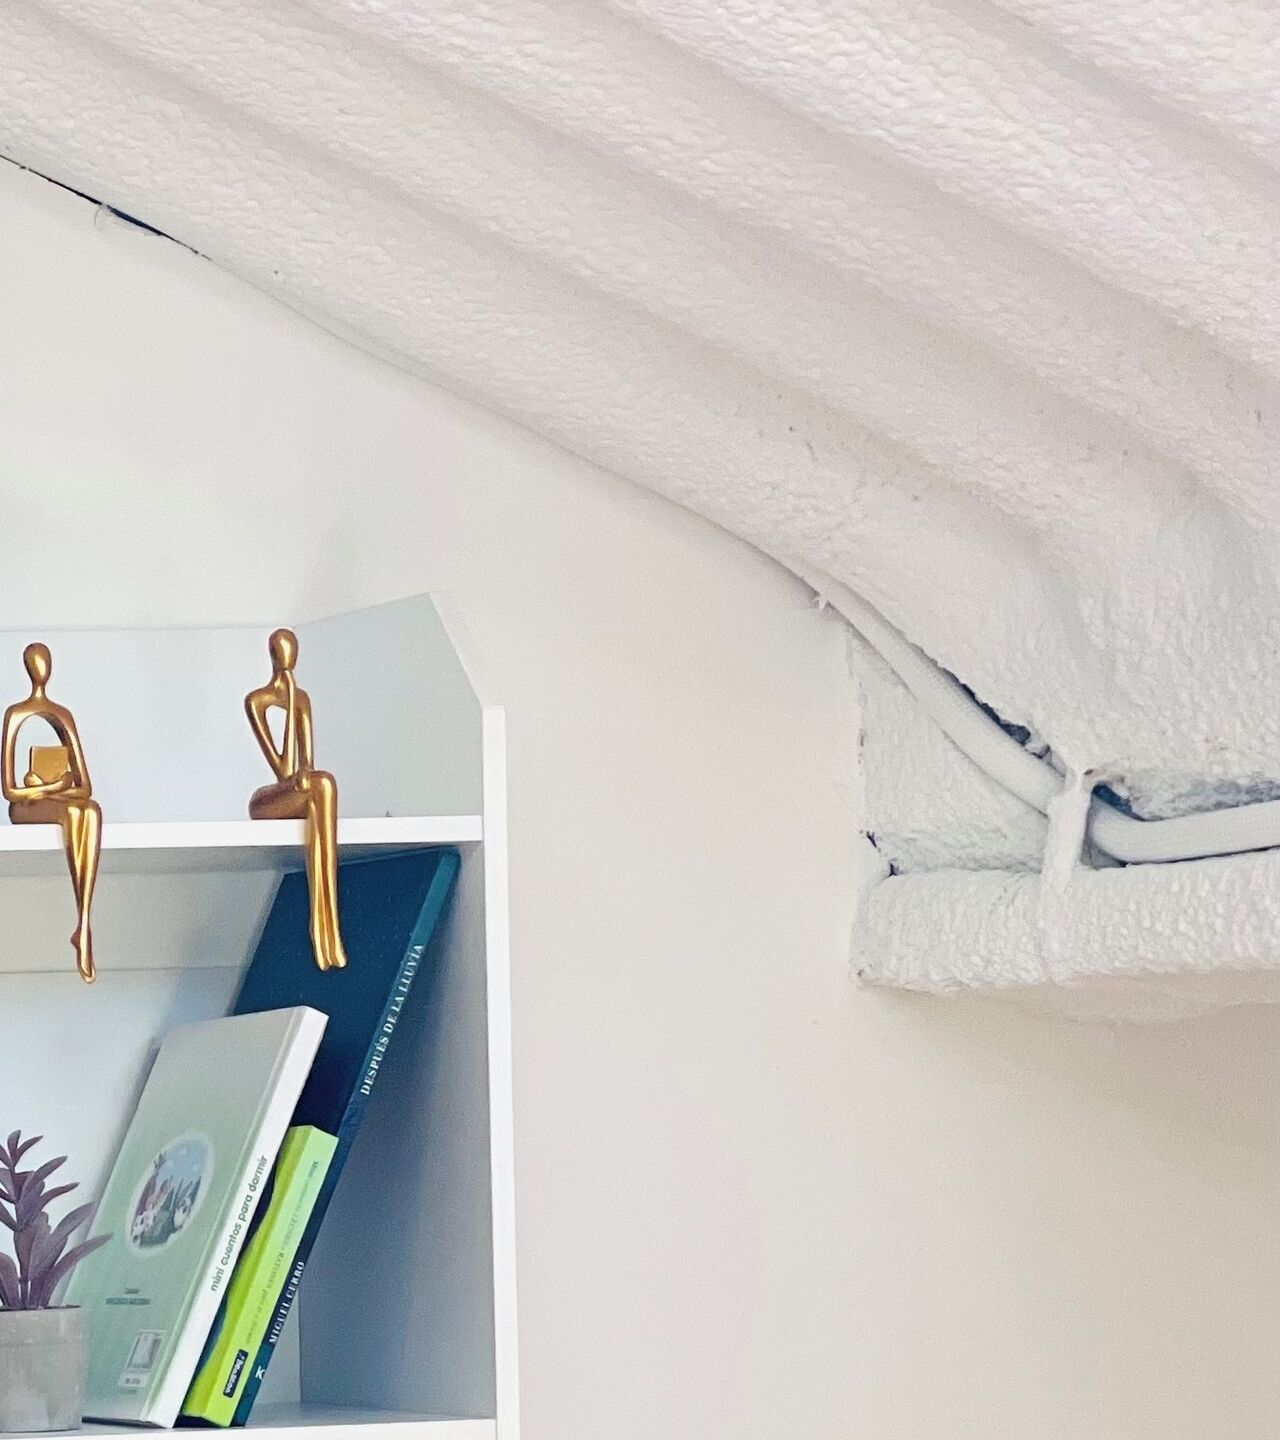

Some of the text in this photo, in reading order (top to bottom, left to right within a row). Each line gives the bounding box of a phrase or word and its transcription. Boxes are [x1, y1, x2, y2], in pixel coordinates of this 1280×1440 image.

[360, 1035, 390, 1096] DESPUÉS
[383, 1014, 398, 1034] DE
[391, 996, 405, 1012] LA
[209, 1155, 269, 1293] mini cuentos para dormir
[268, 1261, 306, 1344] MIGUEL CERRO
